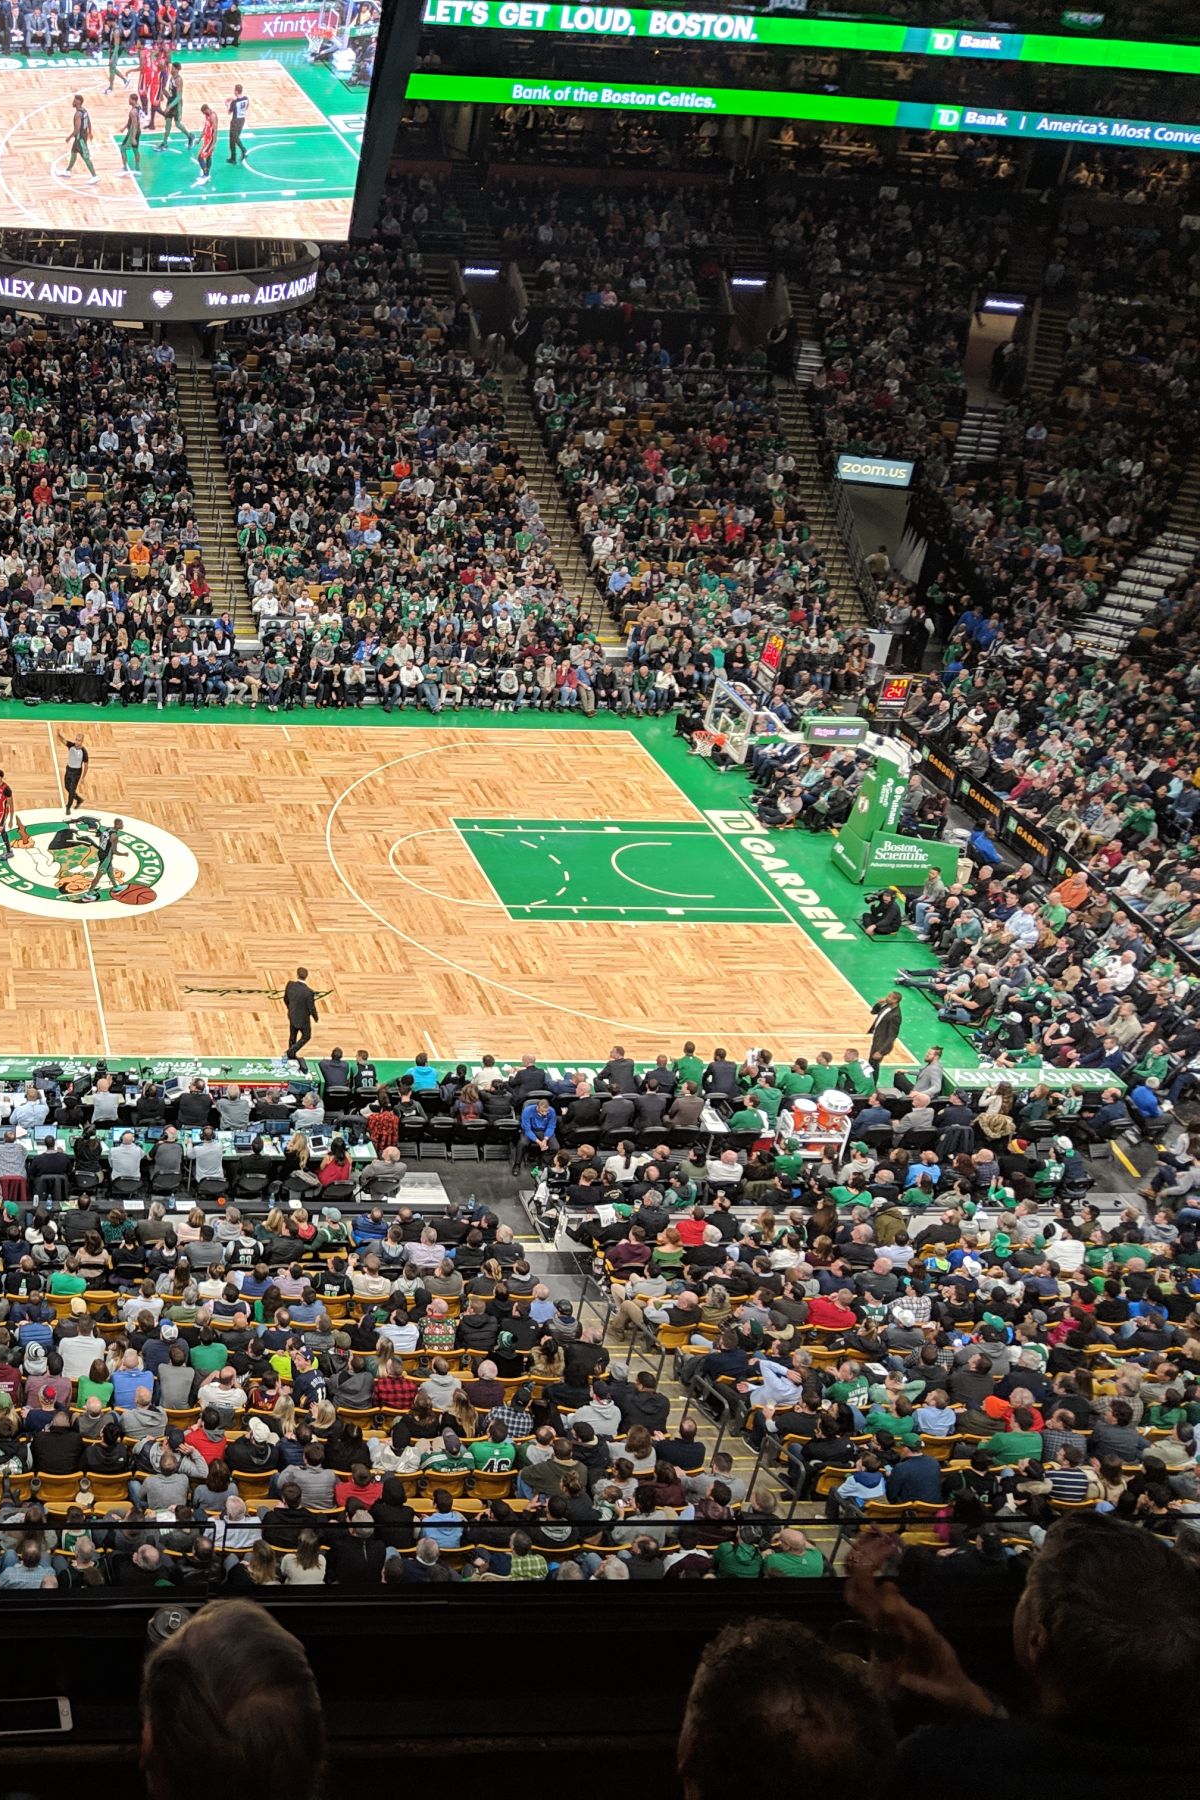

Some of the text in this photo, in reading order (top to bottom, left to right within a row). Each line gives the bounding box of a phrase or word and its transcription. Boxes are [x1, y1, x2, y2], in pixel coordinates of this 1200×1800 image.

[262, 16, 318, 37] xfinity
[423, 0, 758, 40] LET'S GET LOUD, BOSTON.
[933, 33, 1001, 50] TD Bank
[27, 57, 139, 68] Putnm
[512, 84, 717, 109] Bank of the Boston Celtics.
[937, 110, 959, 127] TD
[964, 112, 1008, 127] Bank
[1036, 118, 1108, 136] America's
[1111, 123, 1150, 140] Most
[38, 285, 83, 303] AND
[208, 291, 227, 305] We
[230, 290, 250, 304] are
[254, 282, 286, 304] ALEX
[842, 462, 907, 478] zoom.us
[886, 687, 902, 698] 24
[969, 789, 1001, 817] GARDEN
[883, 841, 917, 851] Boston
[1016, 825, 1049, 857] GARDEN
[119, 834, 161, 885] BOSTON
[875, 848, 929, 861] Scientific
[740, 837, 857, 940] GARDEN
[483, 1458, 511, 1473] 46
